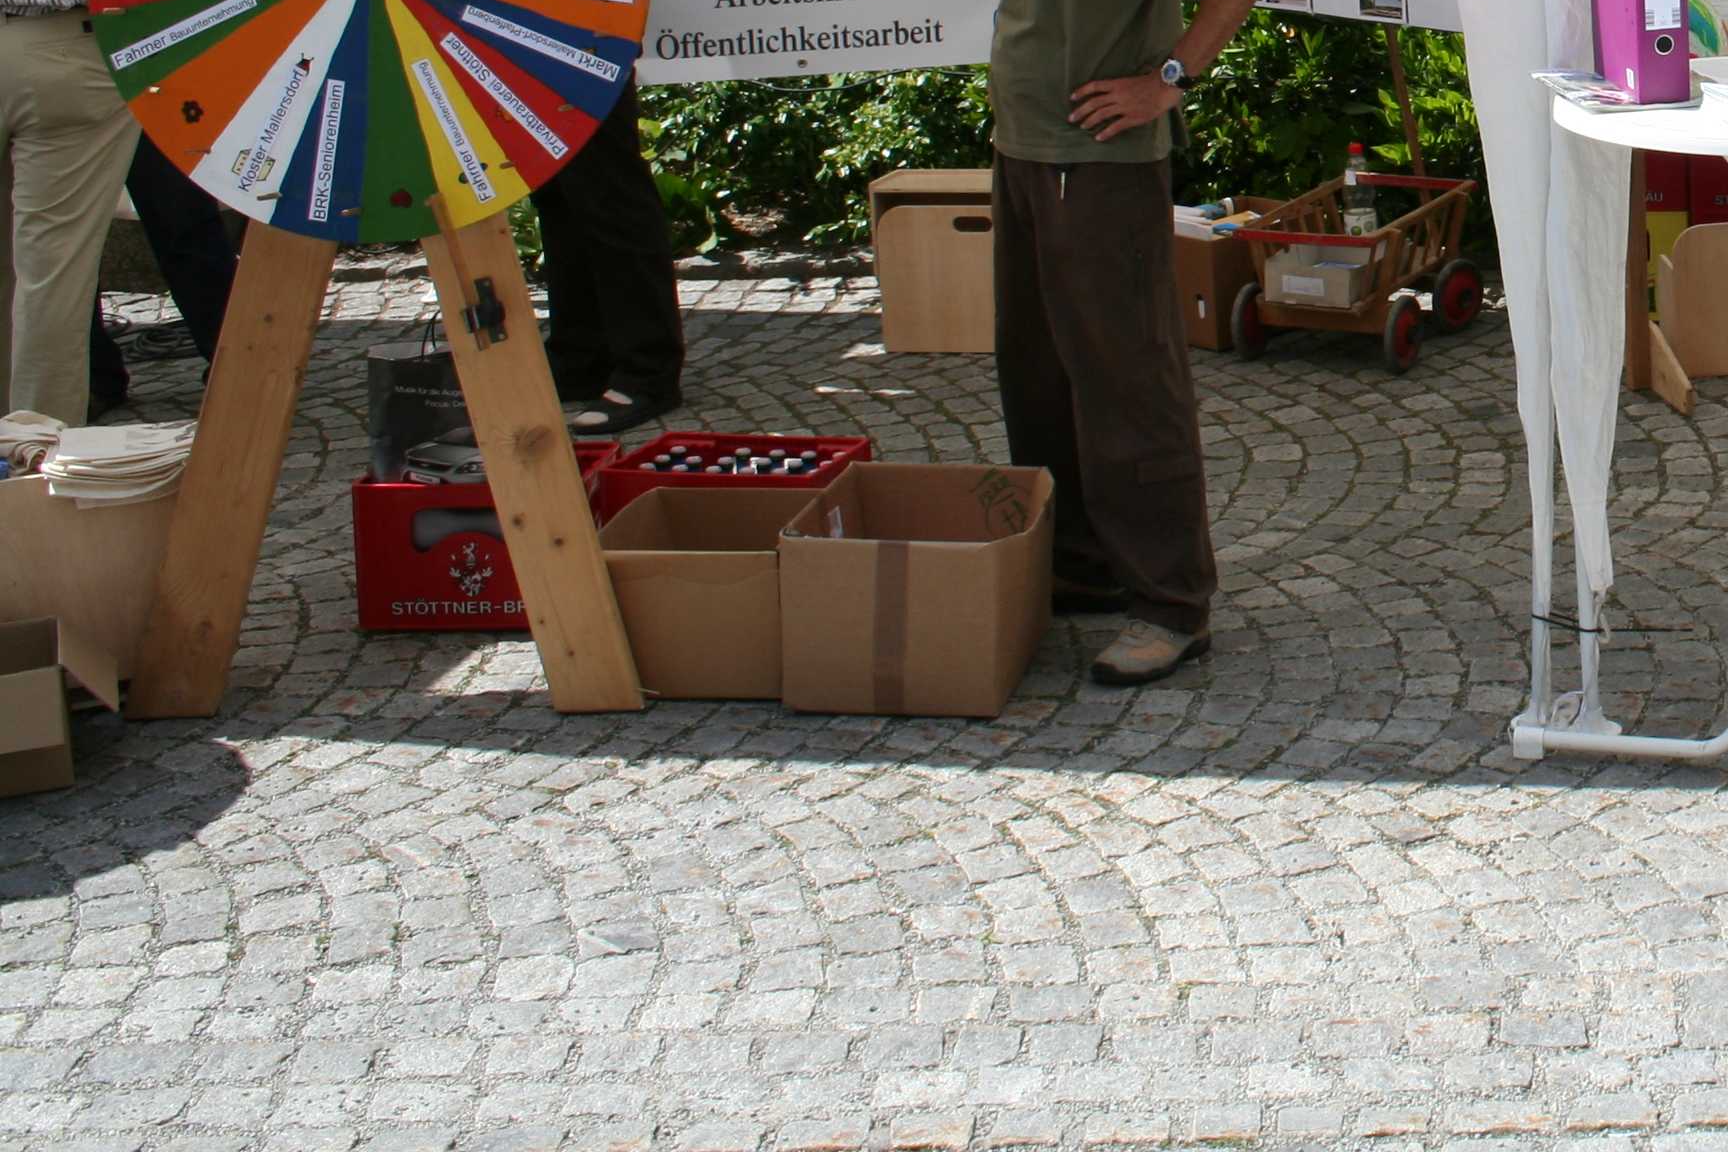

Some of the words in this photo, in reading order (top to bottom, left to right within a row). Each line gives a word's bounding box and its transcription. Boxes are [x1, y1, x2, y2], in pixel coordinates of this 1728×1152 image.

[114, 35, 167, 68] Fahrner
[445, 36, 491, 82] Stöttner
[655, 18, 944, 60] Öffentlichkeitsarbeit
[577, 52, 619, 79] Markt
[238, 143, 267, 193] Kloster
[261, 69, 304, 145] Mallersdorf
[490, 78, 565, 156] Privatbrauerei
[313, 84, 342, 220] BRK-Seniorenheim
[459, 149, 491, 202] Fahrner
